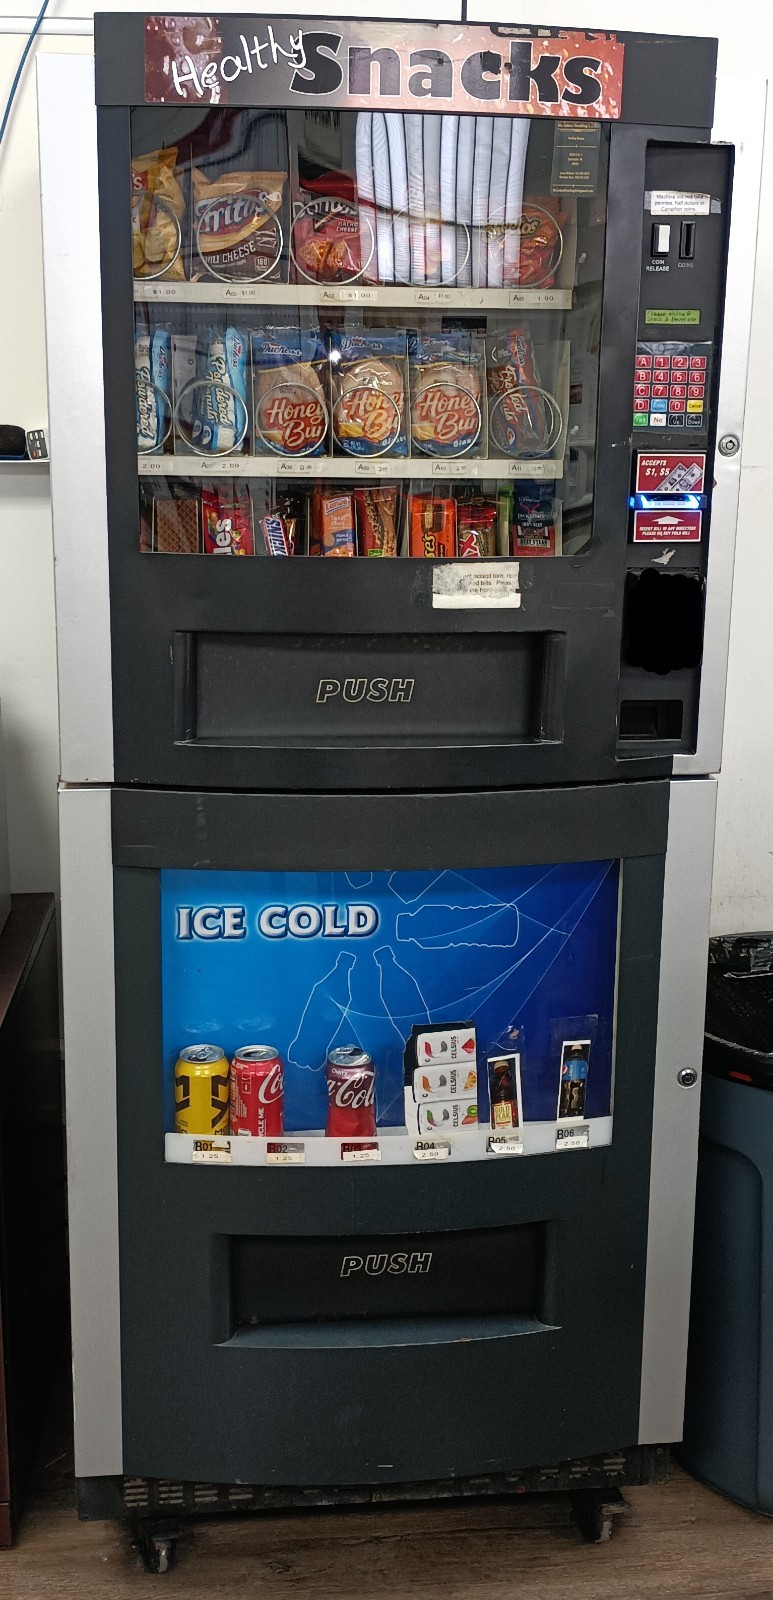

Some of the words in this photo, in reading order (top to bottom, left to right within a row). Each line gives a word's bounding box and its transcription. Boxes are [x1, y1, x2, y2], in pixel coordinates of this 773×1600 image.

[171, 25, 307, 97] Healthy
[289, 30, 603, 106] Snacks
[222, 240, 256, 263] CHEESE
[640, 357, 647, 366] A
[659, 358, 664, 367] 1
[677, 358, 684, 367] 2
[695, 358, 701, 367] 3
[640, 372, 646, 381] B
[657, 372, 664, 381] 4
[676, 373, 683, 382] 5
[694, 373, 700, 382] 6
[500, 364, 529, 416] Froted
[638, 386, 645, 395] C
[657, 387, 664, 395] 7
[675, 387, 682, 396] 8
[693, 387, 700, 396] 9
[419, 391, 481, 417] Honey
[637, 401, 645, 410] D
[674, 401, 681, 410] 0
[266, 399, 324, 425] Honey
[645, 468, 657, 477] $1,
[659, 468, 670, 476] $5
[315, 677, 415, 703] PUSH
[177, 905, 247, 940] ICE
[258, 903, 380, 939] COLD
[494, 1105, 510, 1113] GOLD
[557, 1128, 575, 1139] B06
[195, 1141, 213, 1151] B01
[416, 1141, 436, 1150] B04
[488, 1136, 506, 1146] B05
[269, 1144, 288, 1153] B02
[340, 1252, 433, 1277] PUSH
